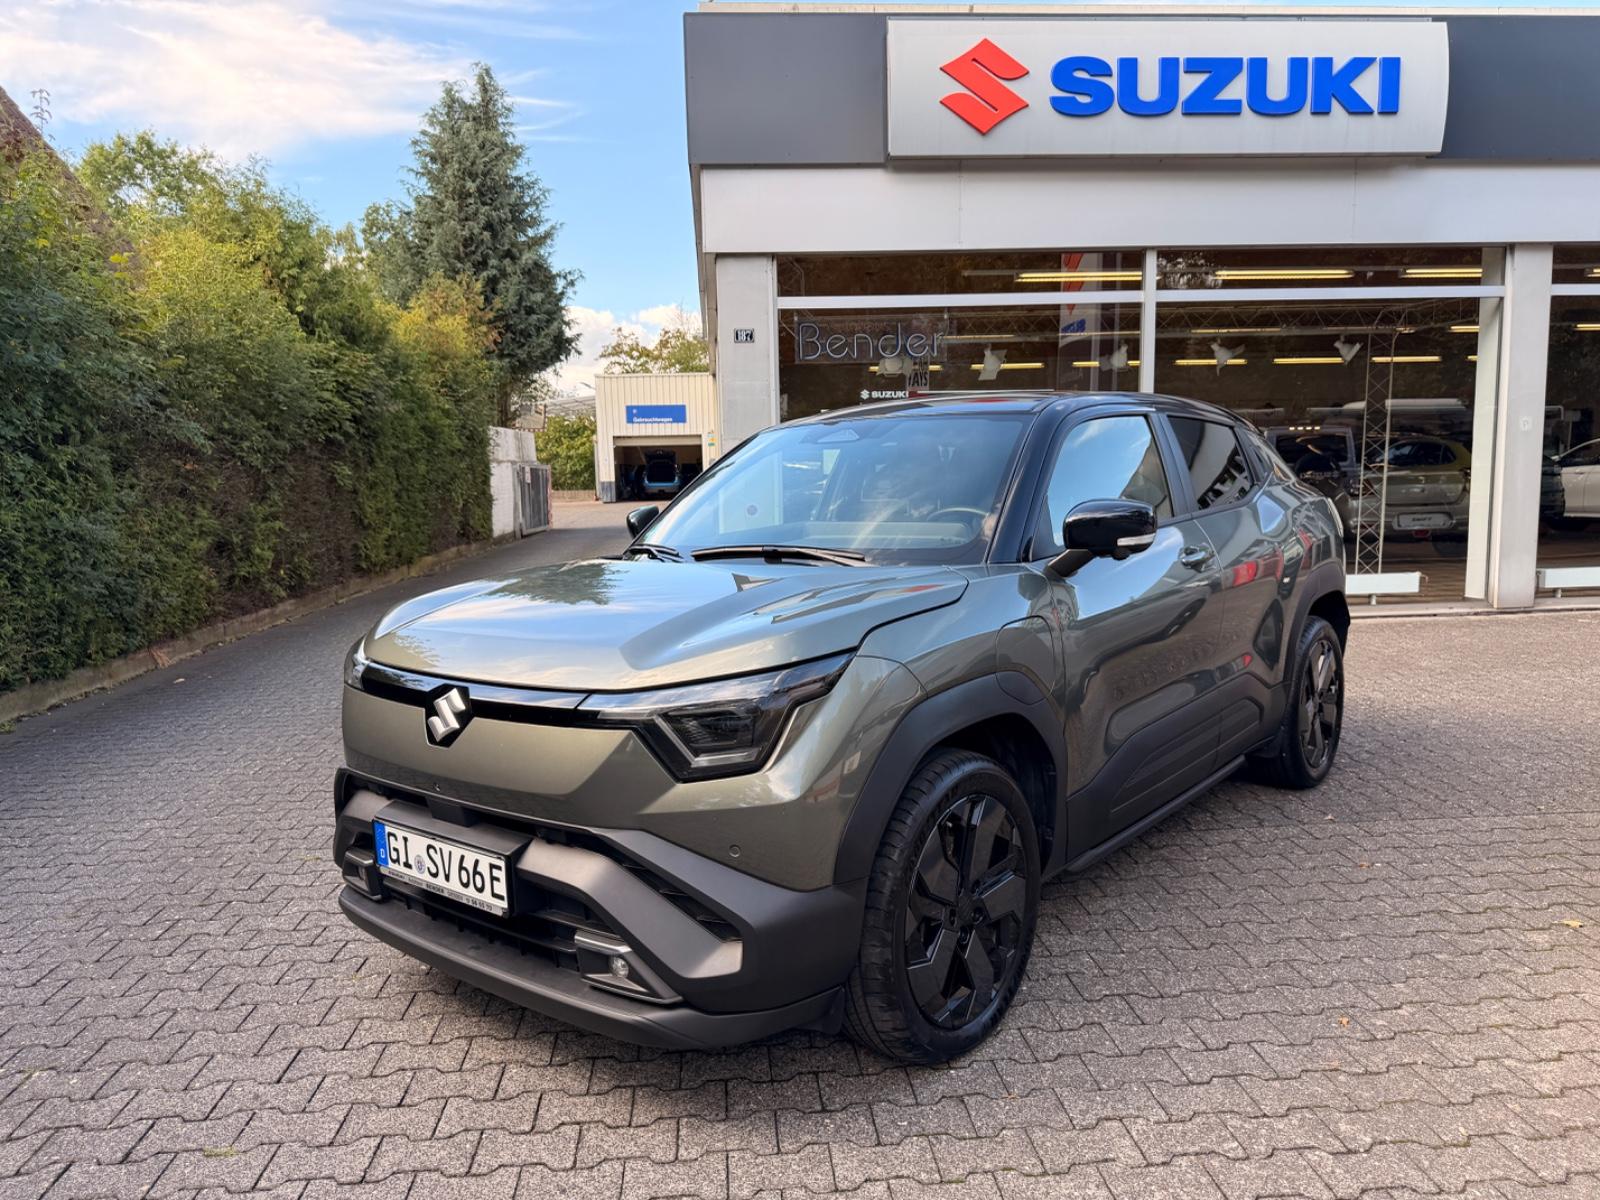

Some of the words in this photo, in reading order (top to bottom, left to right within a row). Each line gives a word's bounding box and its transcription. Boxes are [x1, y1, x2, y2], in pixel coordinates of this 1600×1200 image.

[1049, 56, 1402, 117] SUZUKI
[799, 322, 944, 361] Bender
[871, 390, 909, 398] SUZUKI
[387, 831, 413, 870] GI
